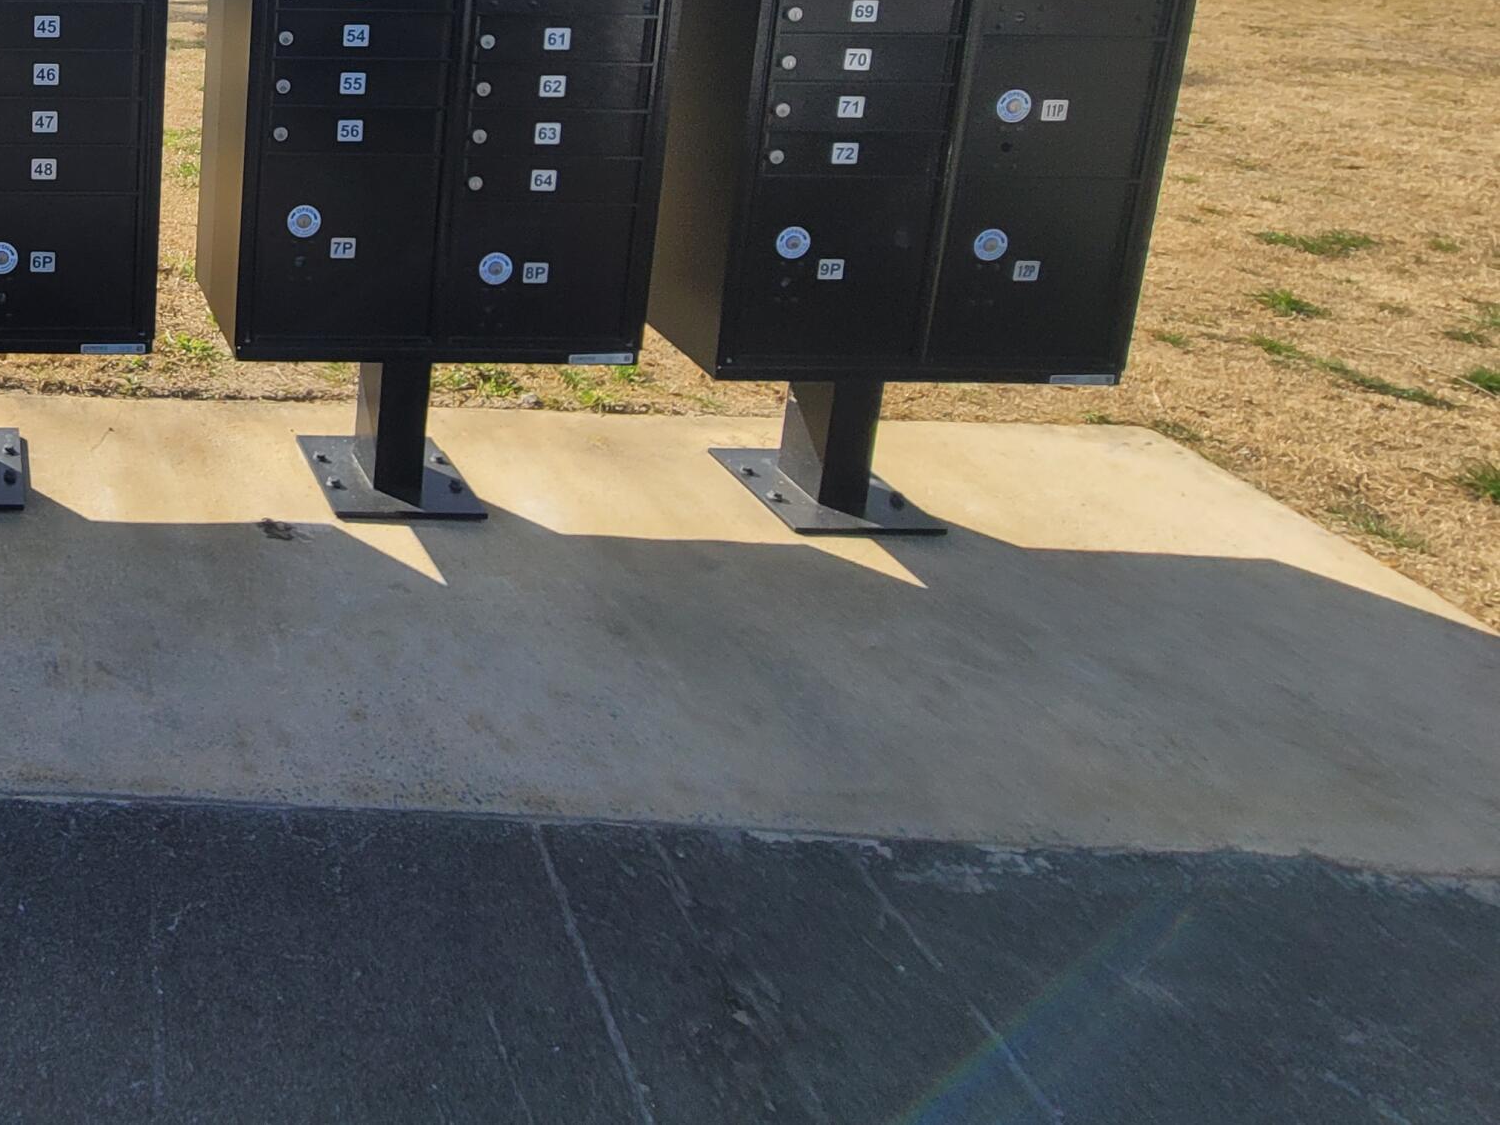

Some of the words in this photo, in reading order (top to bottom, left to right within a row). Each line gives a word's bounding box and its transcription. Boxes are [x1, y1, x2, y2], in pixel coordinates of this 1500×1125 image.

[854, 4, 875, 19] 69
[35, 19, 57, 34] 45
[346, 28, 367, 44] 54
[547, 32, 566, 46] 61
[848, 52, 868, 67] 70
[35, 67, 57, 82] 46
[342, 76, 363, 92] 55
[542, 79, 563, 94] 62
[841, 100, 860, 114] 71
[1046, 103, 1065, 118] 11P
[34, 114, 55, 130] 47
[340, 124, 360, 139] 56
[537, 126, 557, 141] 63
[835, 146, 855, 161] 72
[33, 162, 53, 177] 48
[533, 173, 553, 188] 64
[333, 241, 354, 256] 7P
[31, 254, 54, 270] 6P
[819, 262, 842, 276] 9P
[524, 266, 547, 280] 8P
[1017, 264, 1037, 278] 12P
